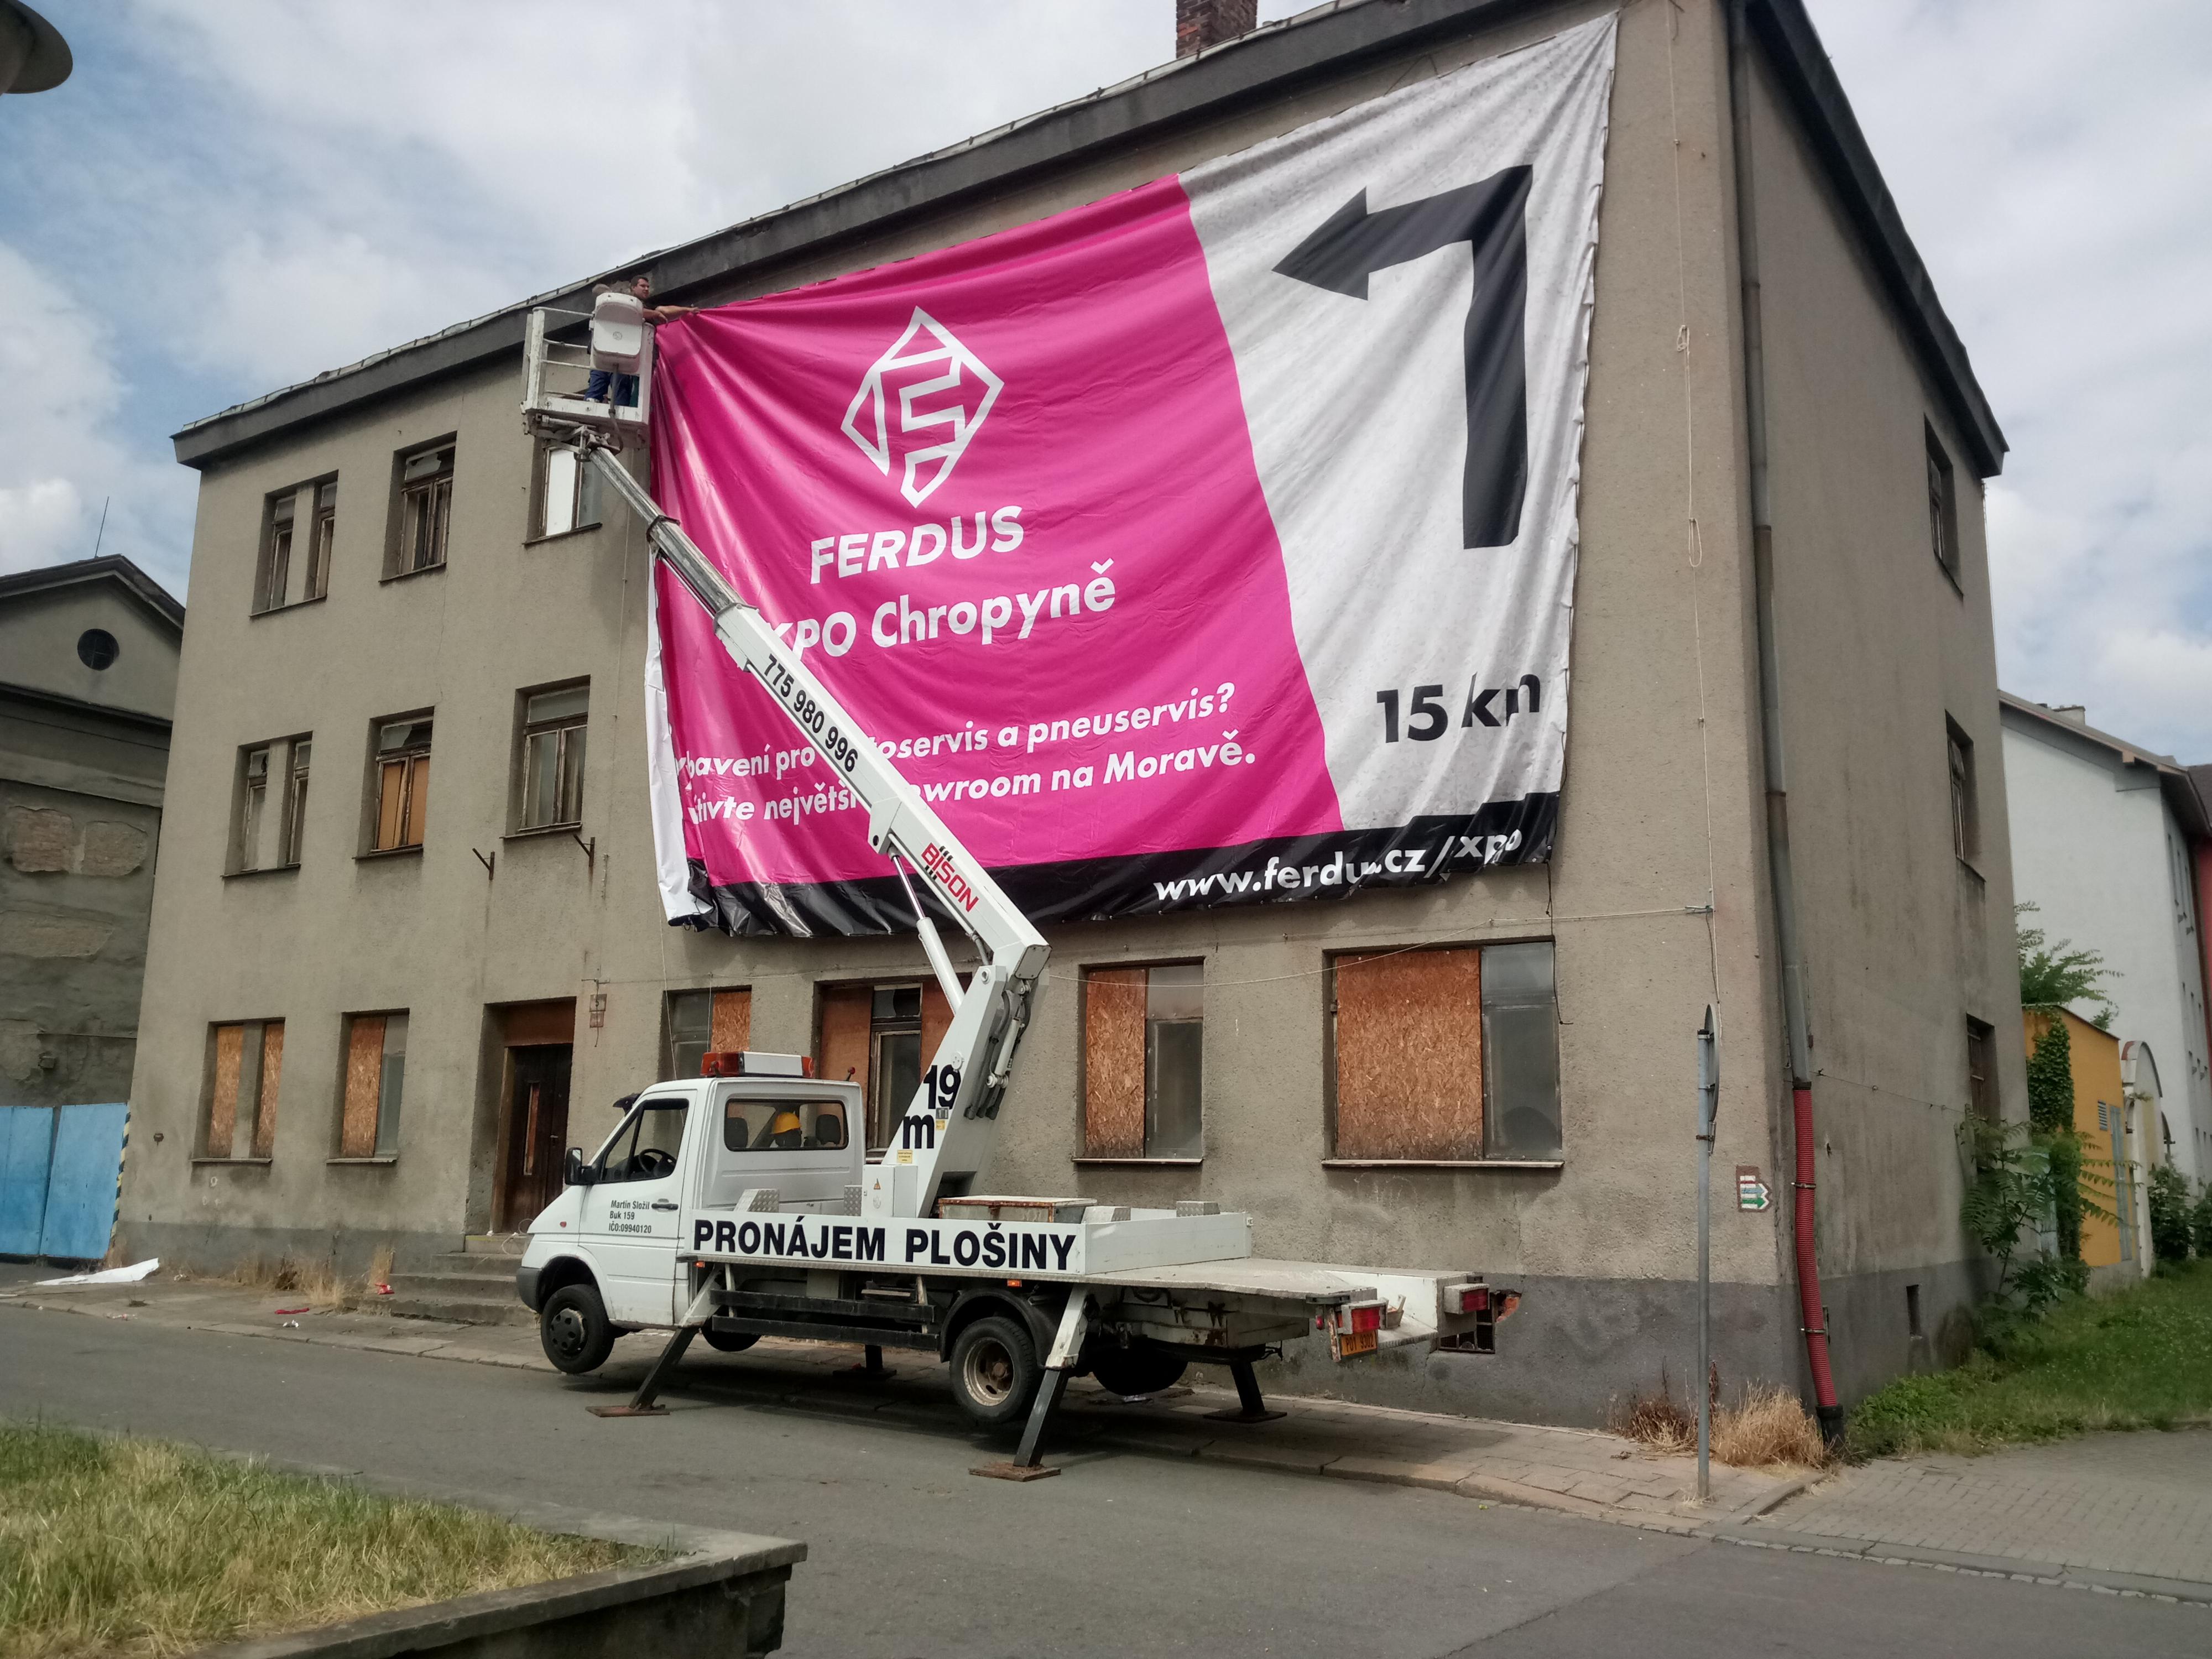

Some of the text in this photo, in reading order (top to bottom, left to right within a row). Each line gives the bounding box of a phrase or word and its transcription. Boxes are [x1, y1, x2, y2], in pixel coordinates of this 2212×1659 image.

[810, 505, 1024, 585] FERDUS
[871, 558, 1116, 648] Chropyně
[764, 653, 858, 772] 775 980 996
[776, 747, 815, 780] pro
[997, 726, 1019, 747] a
[1027, 682, 1235, 753] pneuservis?
[1377, 684, 1448, 743] 15
[1051, 766, 1094, 791] na
[1103, 728, 1255, 784] Moravě.
[921, 842, 979, 912] BISON
[924, 1064, 961, 1109] 19
[902, 1114, 935, 1149] m
[608, 1220, 651, 1233] IČO:09940120
[609, 1211, 635, 1220] Buk 159
[632, 1201, 650, 1209] Složil
[693, 1215, 1077, 1270] PRONÁJEM PLOŠINY
